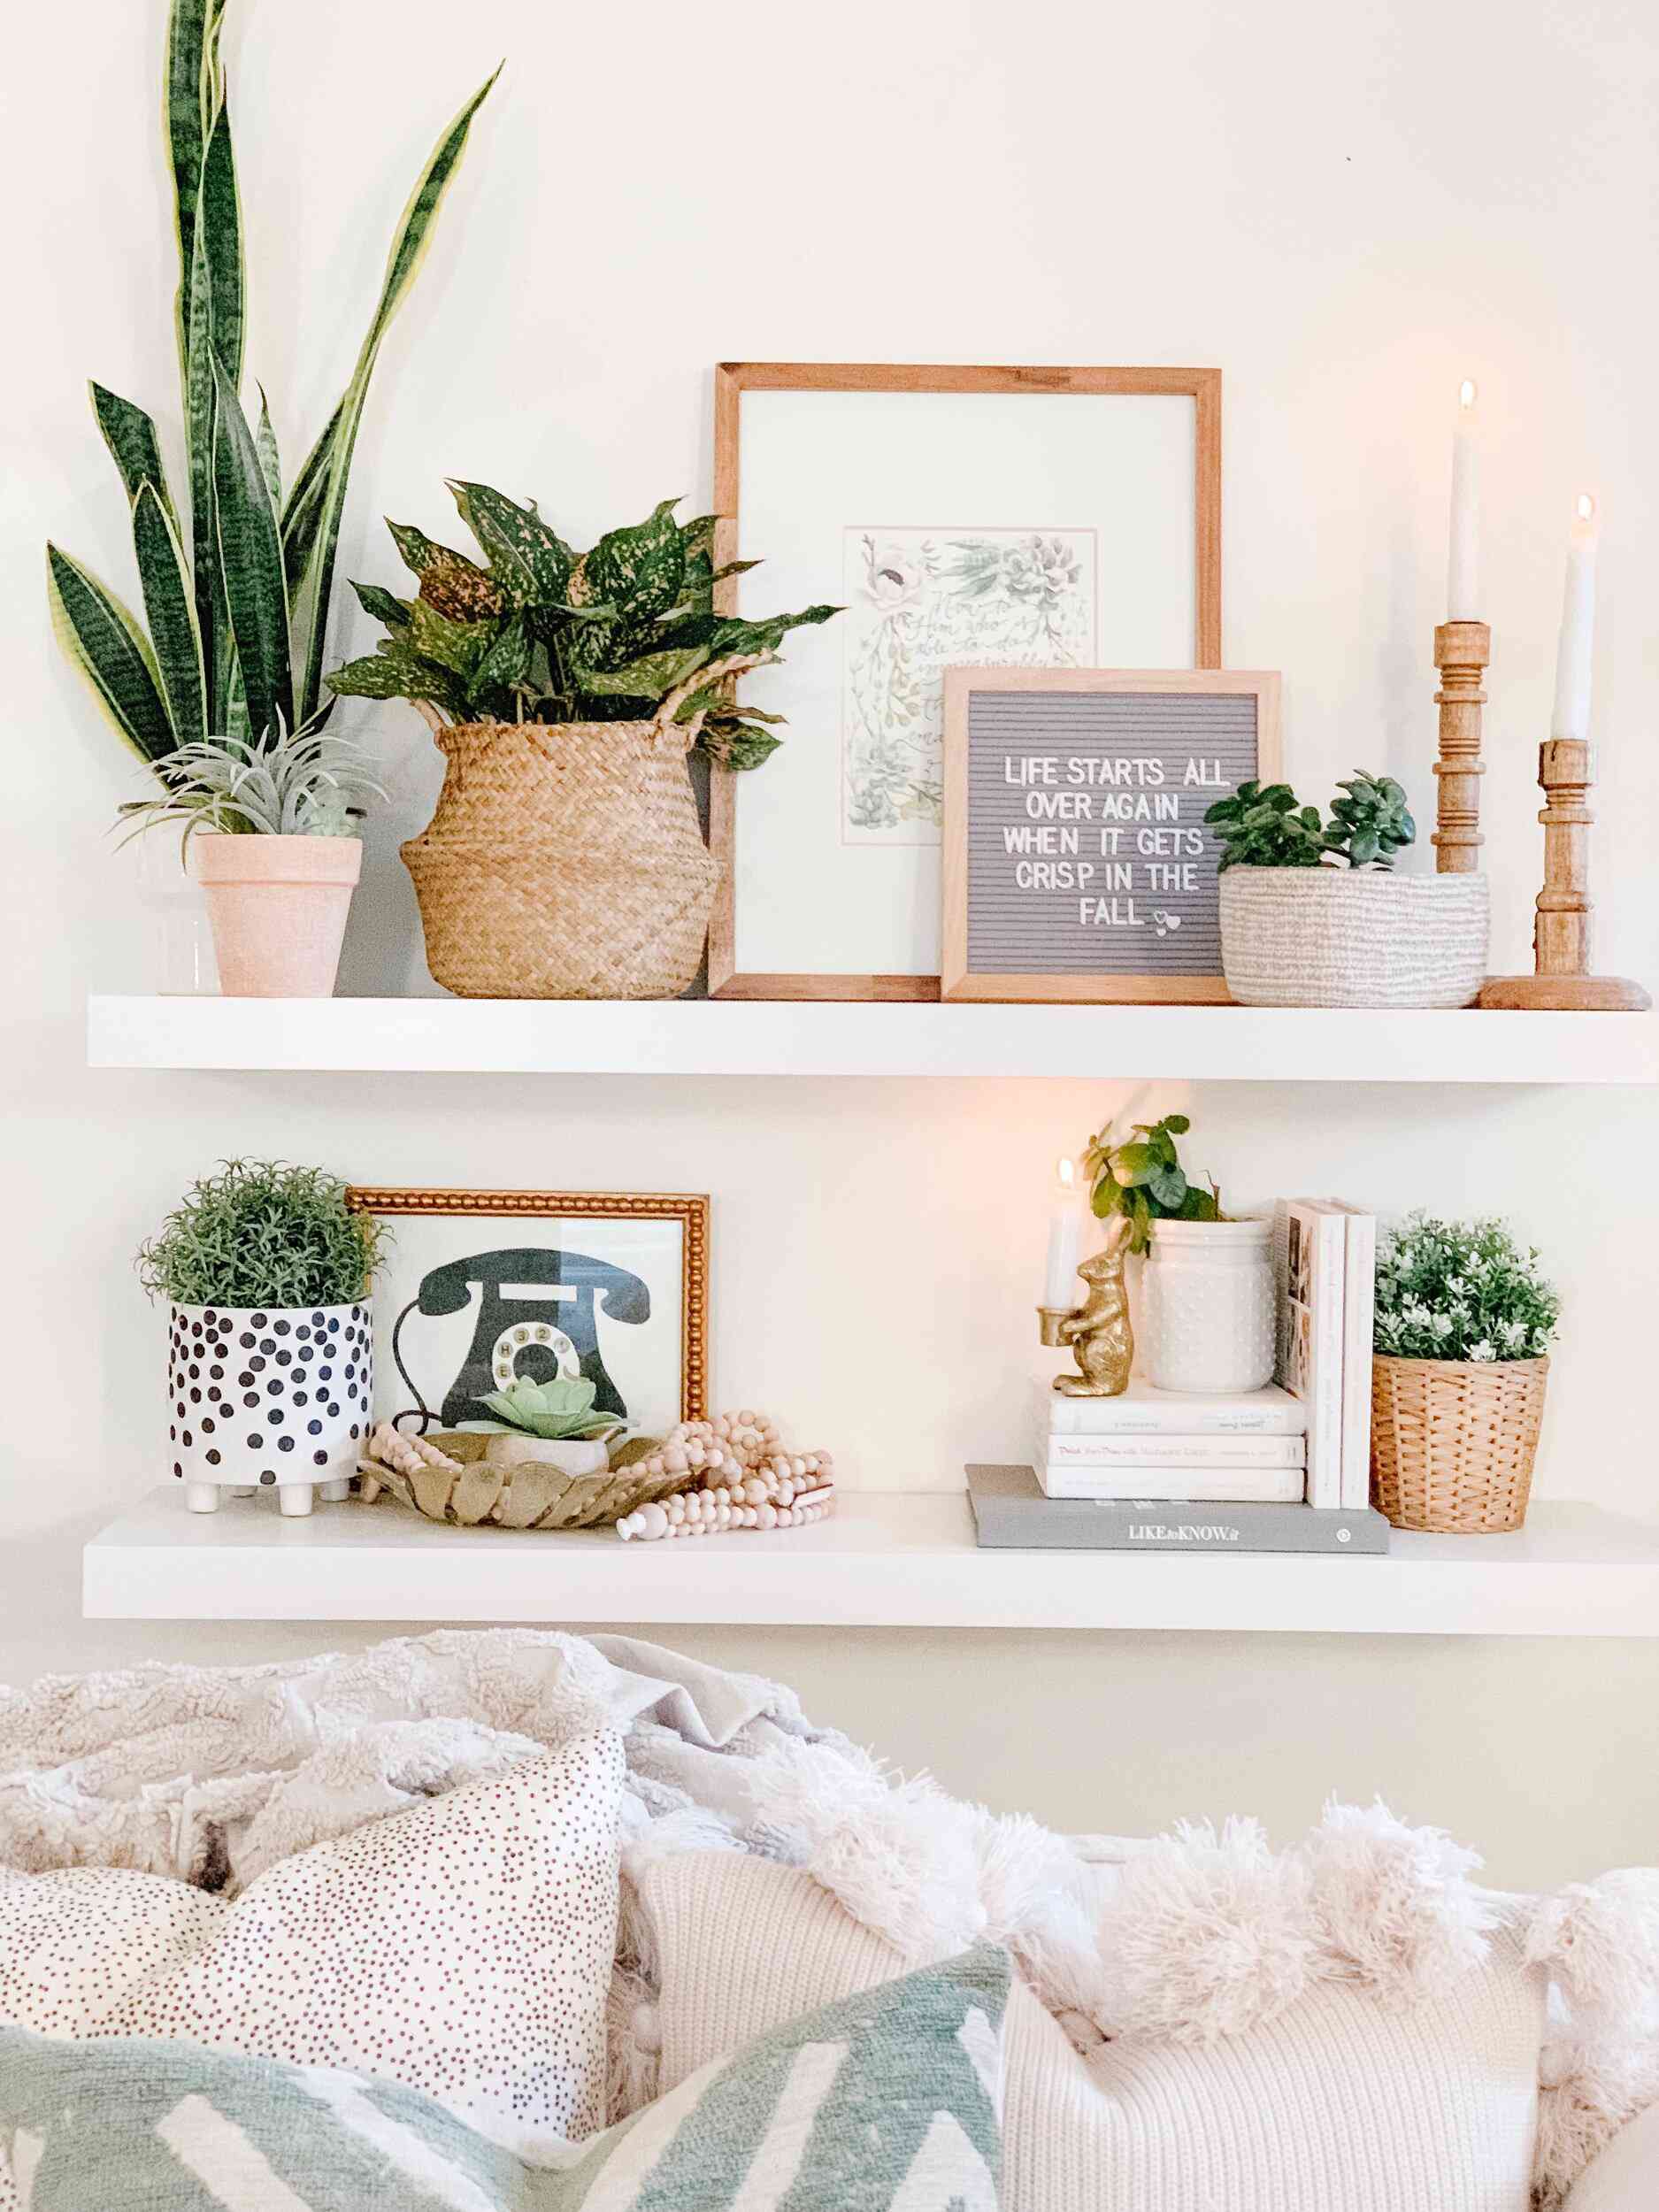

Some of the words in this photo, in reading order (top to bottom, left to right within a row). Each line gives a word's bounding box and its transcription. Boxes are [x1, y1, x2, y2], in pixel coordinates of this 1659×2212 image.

[1005, 757, 1058, 787] LIFE
[1067, 758, 1164, 787] STARTS
[1184, 758, 1231, 787] ALL
[1025, 792, 1092, 820] OVER
[1102, 794, 1179, 822] AGAIN
[1002, 827, 1079, 856] WHEN
[1101, 828, 1124, 856] IT
[1137, 828, 1204, 856] GETS
[1016, 862, 1094, 890] CRISP
[1106, 864, 1133, 891] IN
[1145, 864, 1200, 891] THE
[1079, 898, 1145, 926] FALL
